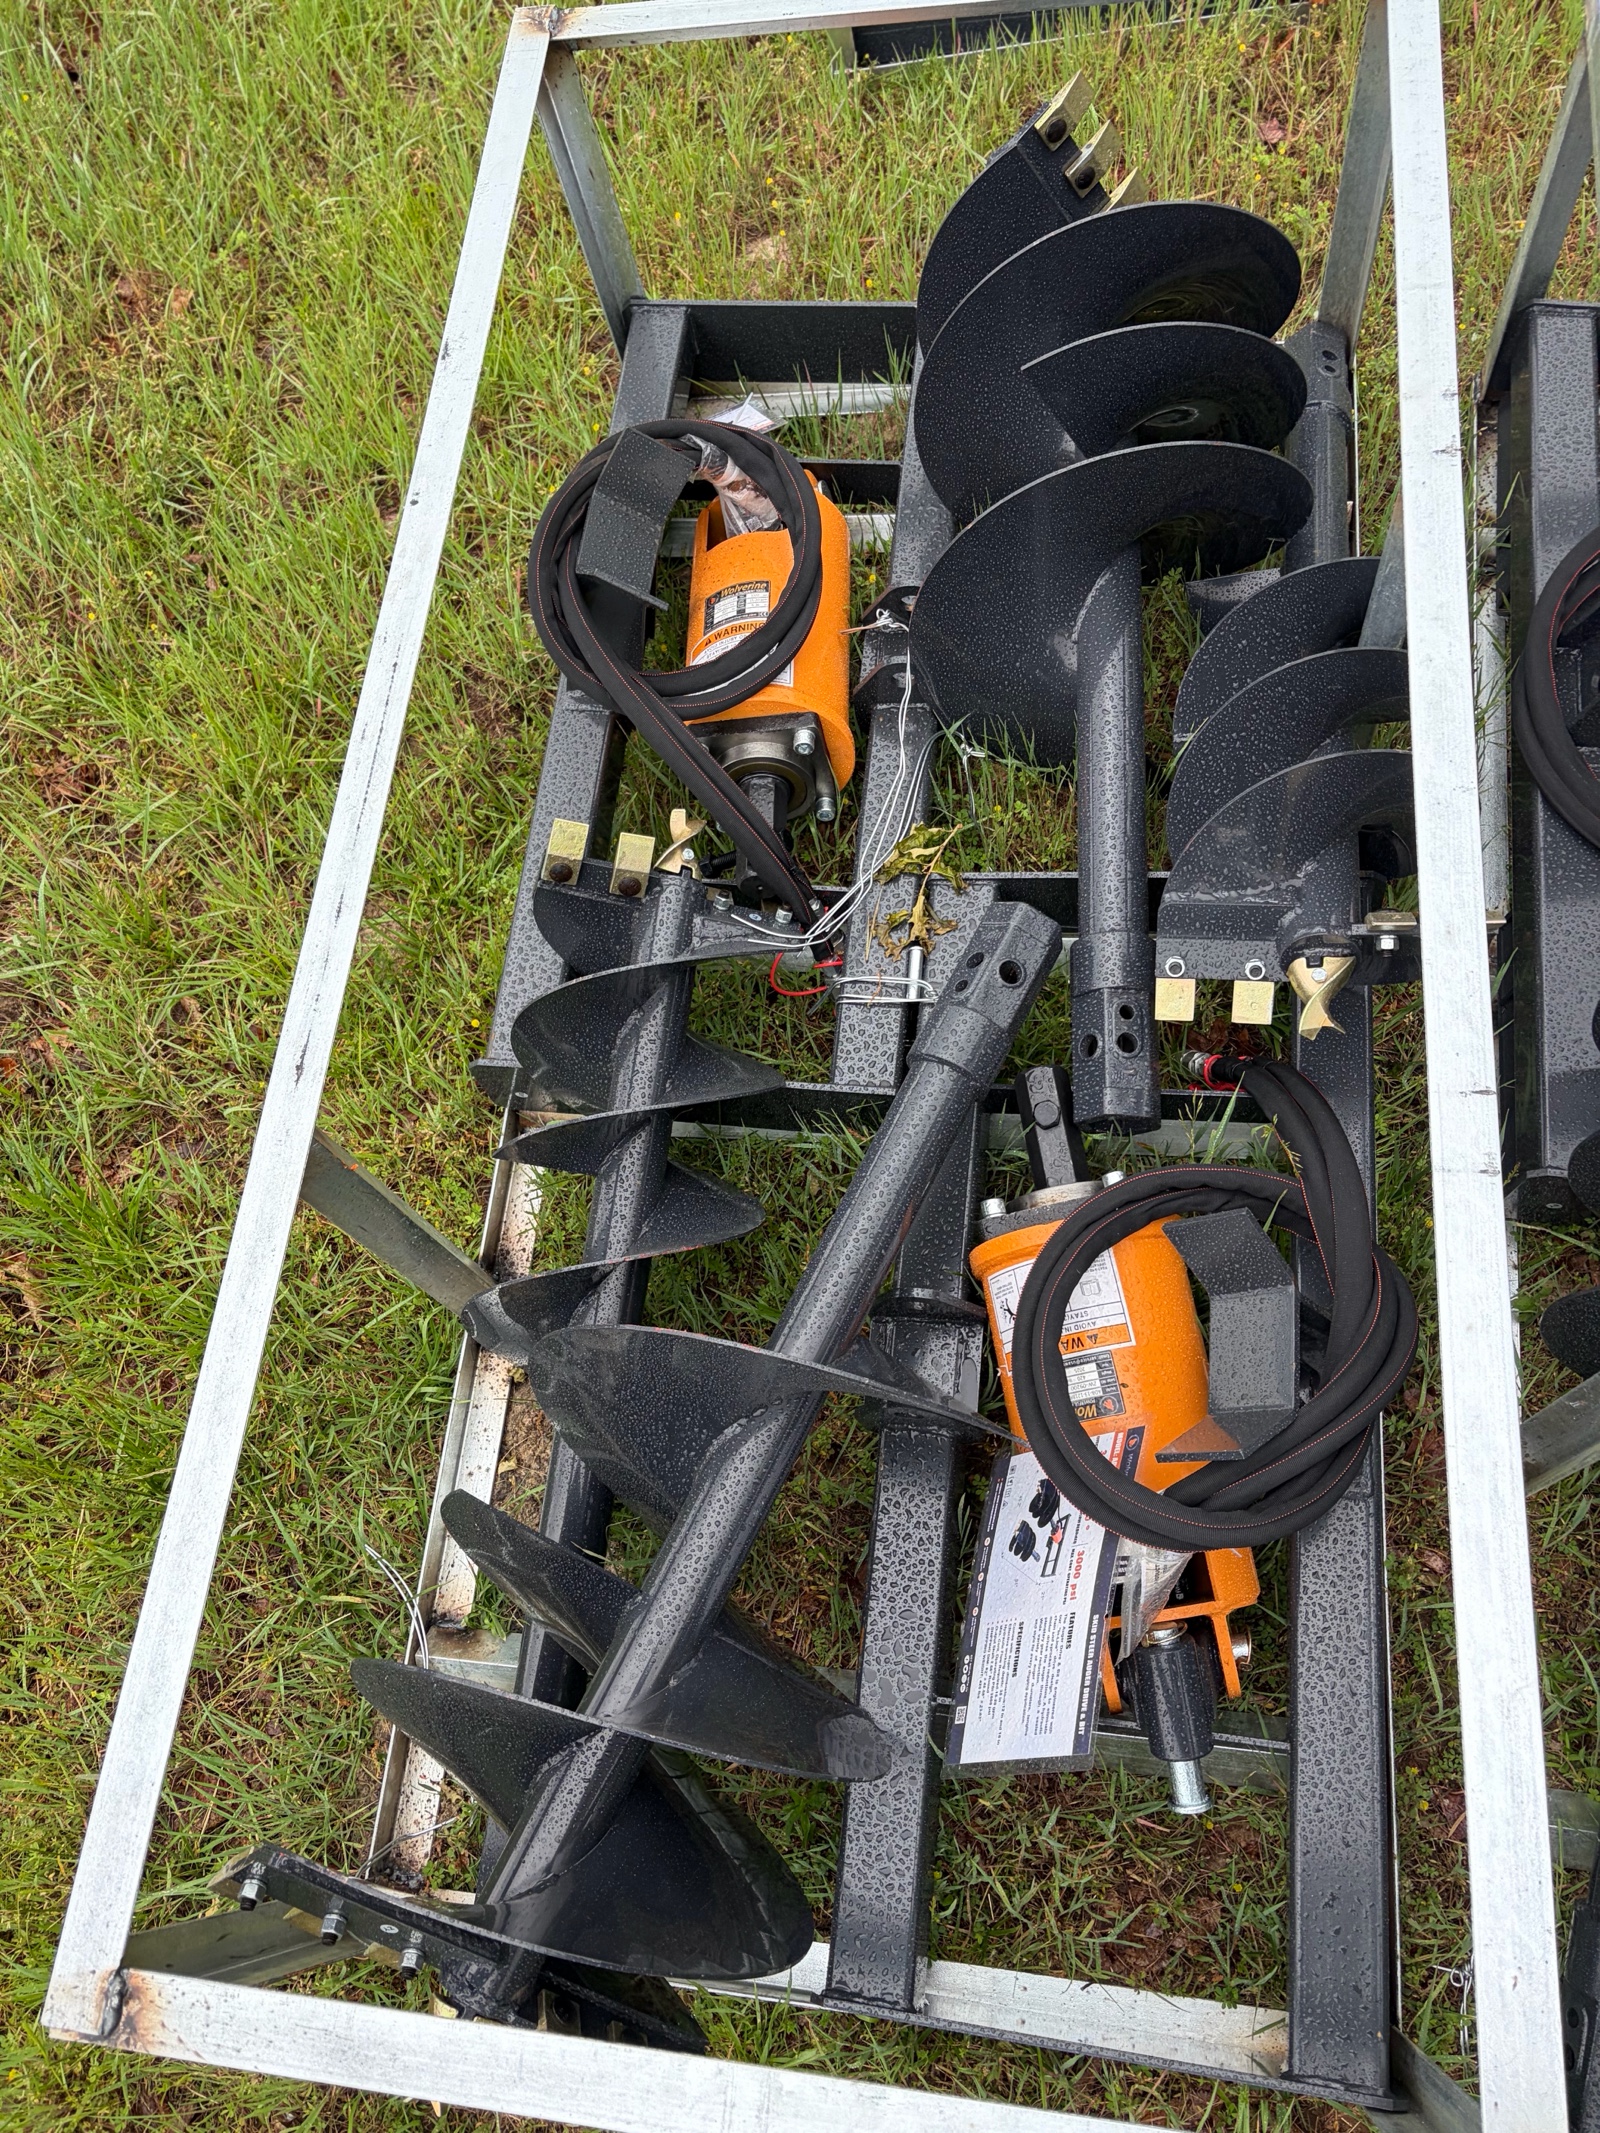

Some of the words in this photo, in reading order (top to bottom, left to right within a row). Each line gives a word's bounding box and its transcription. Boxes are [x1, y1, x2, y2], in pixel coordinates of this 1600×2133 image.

[720, 582, 767, 597] Wolverine
[1113, 1431, 1123, 1457] MODEL:
[1073, 1549, 1084, 1579] 3000
[1068, 1582, 1078, 1601] psi
[1065, 1611, 1075, 1649] FEATURES
[1090, 1613, 1099, 1633] SKID
[1011, 1620, 1024, 1678] SPECIFICTIONS
[1087, 1634, 1096, 1658] STEER
[1083, 1659, 1093, 1686] AUGER
[1080, 1686, 1089, 1712] DRIVE
[1077, 1720, 1085, 1735] BIT
[1079, 1712, 1086, 1720] &
